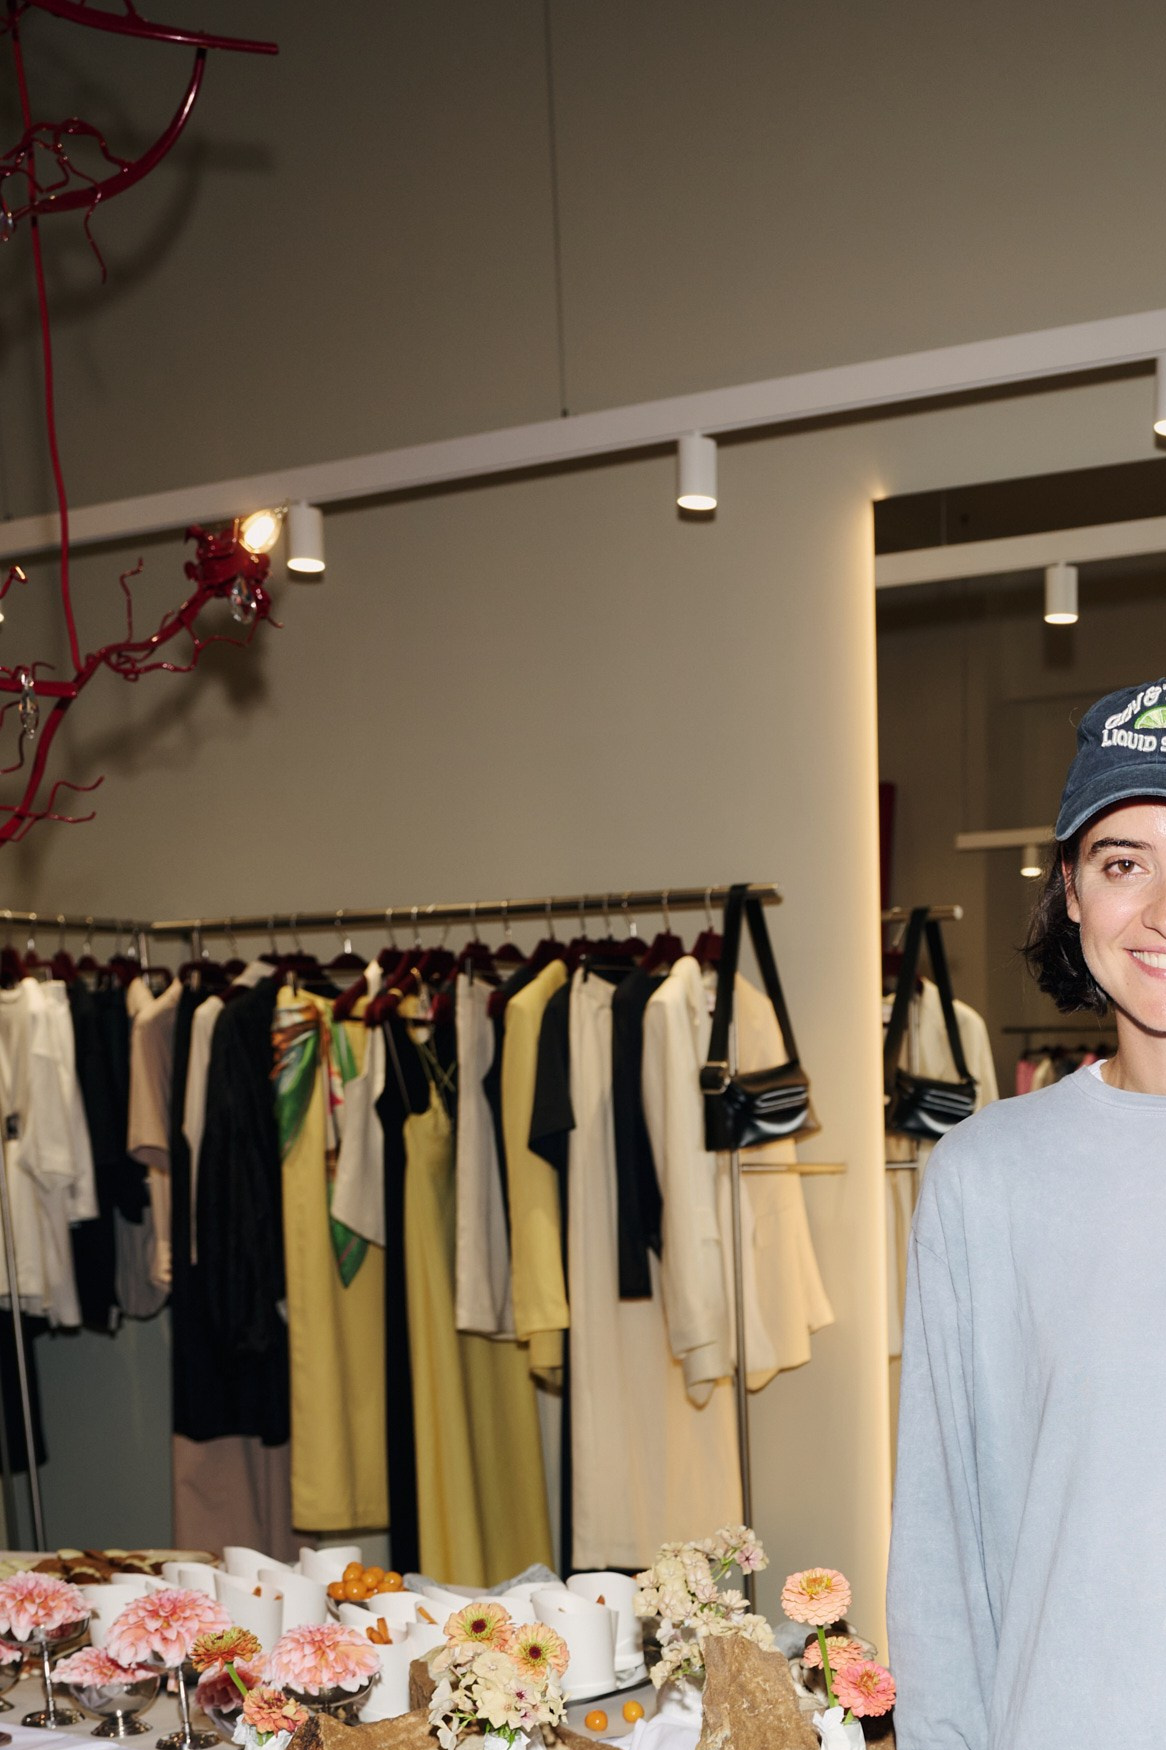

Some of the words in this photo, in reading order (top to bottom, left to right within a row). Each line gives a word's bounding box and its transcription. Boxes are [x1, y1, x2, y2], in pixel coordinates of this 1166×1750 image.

[1105, 692, 1144, 729] GIN
[1144, 686, 1162, 706] &
[1101, 729, 1157, 752] LIQUID
